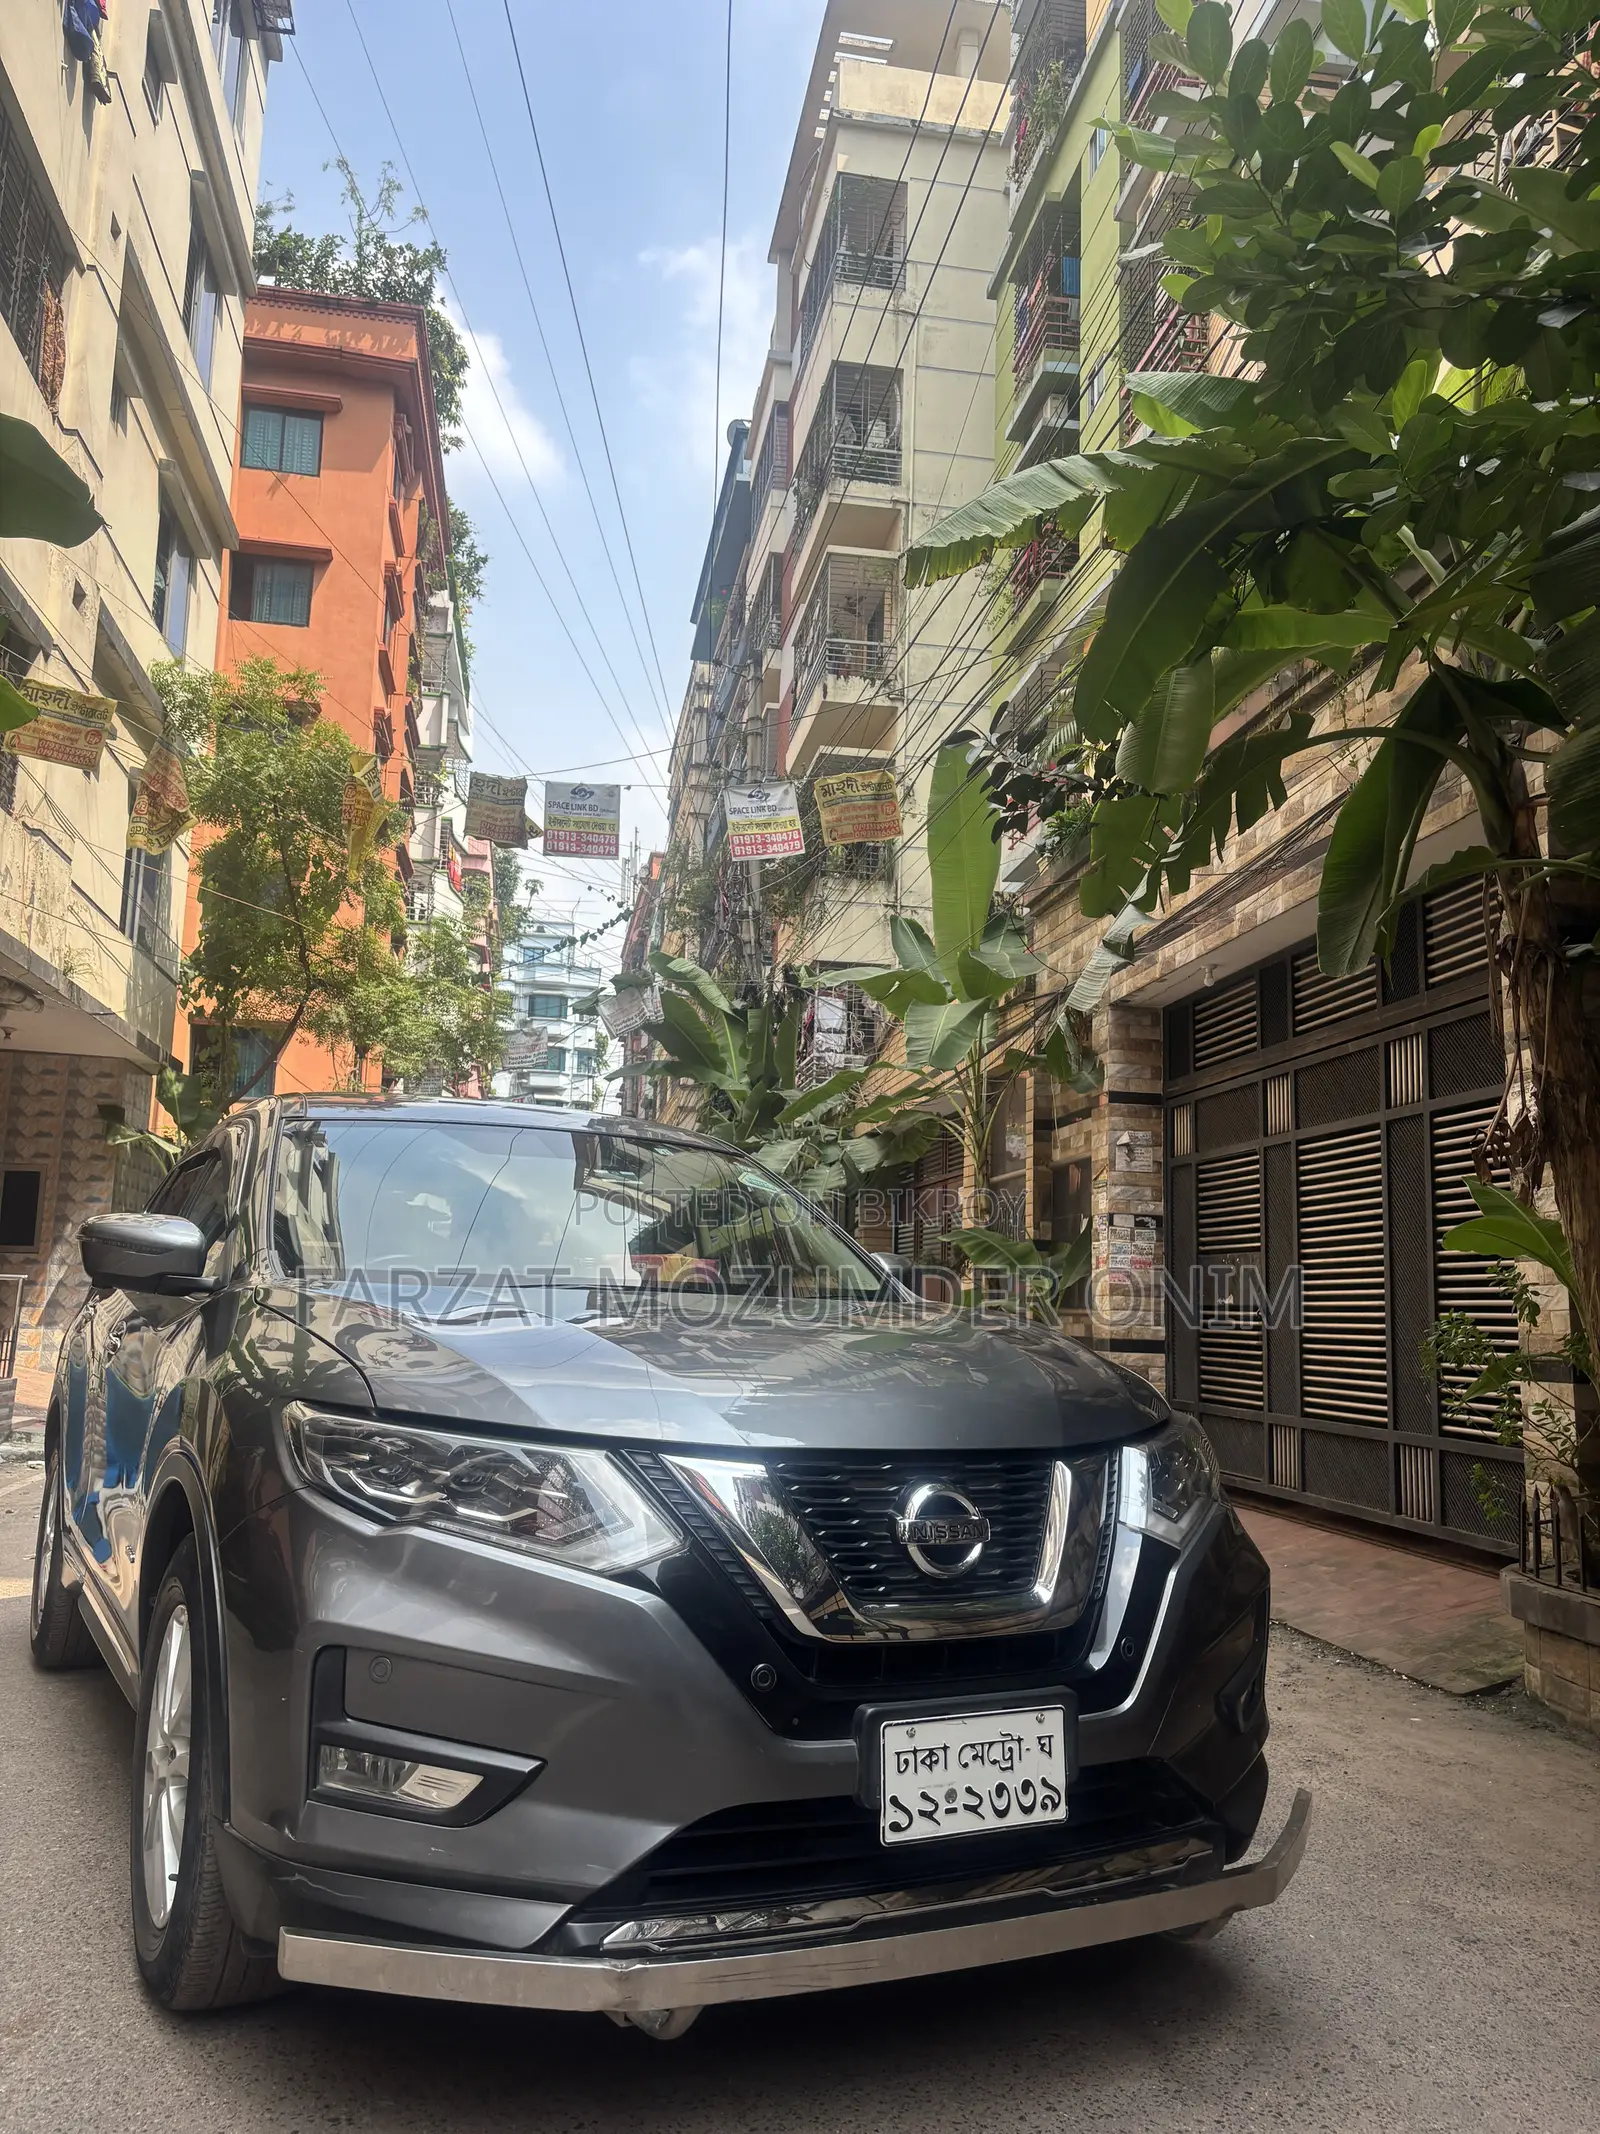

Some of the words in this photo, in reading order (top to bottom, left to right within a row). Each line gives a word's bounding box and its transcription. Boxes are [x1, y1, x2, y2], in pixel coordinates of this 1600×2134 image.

[548, 800, 570, 810] SPACE
[571, 803, 587, 811] LINK
[588, 804, 599, 812] BD
[729, 806, 750, 815] SPACE
[750, 804, 767, 813] LINK
[767, 804, 777, 812] BD
[546, 829, 616, 844] 01913-340478
[733, 830, 800, 845] 01913-340478
[546, 841, 617, 855] 01913-340479
[734, 840, 801, 856] 01913-340479
[912, 1523, 985, 1541] NISSAN
[894, 1742, 950, 1775] ঢাকা
[1036, 1732, 1055, 1760] ঘ
[888, 1776, 1062, 1833] ১২-২৩৩৯
